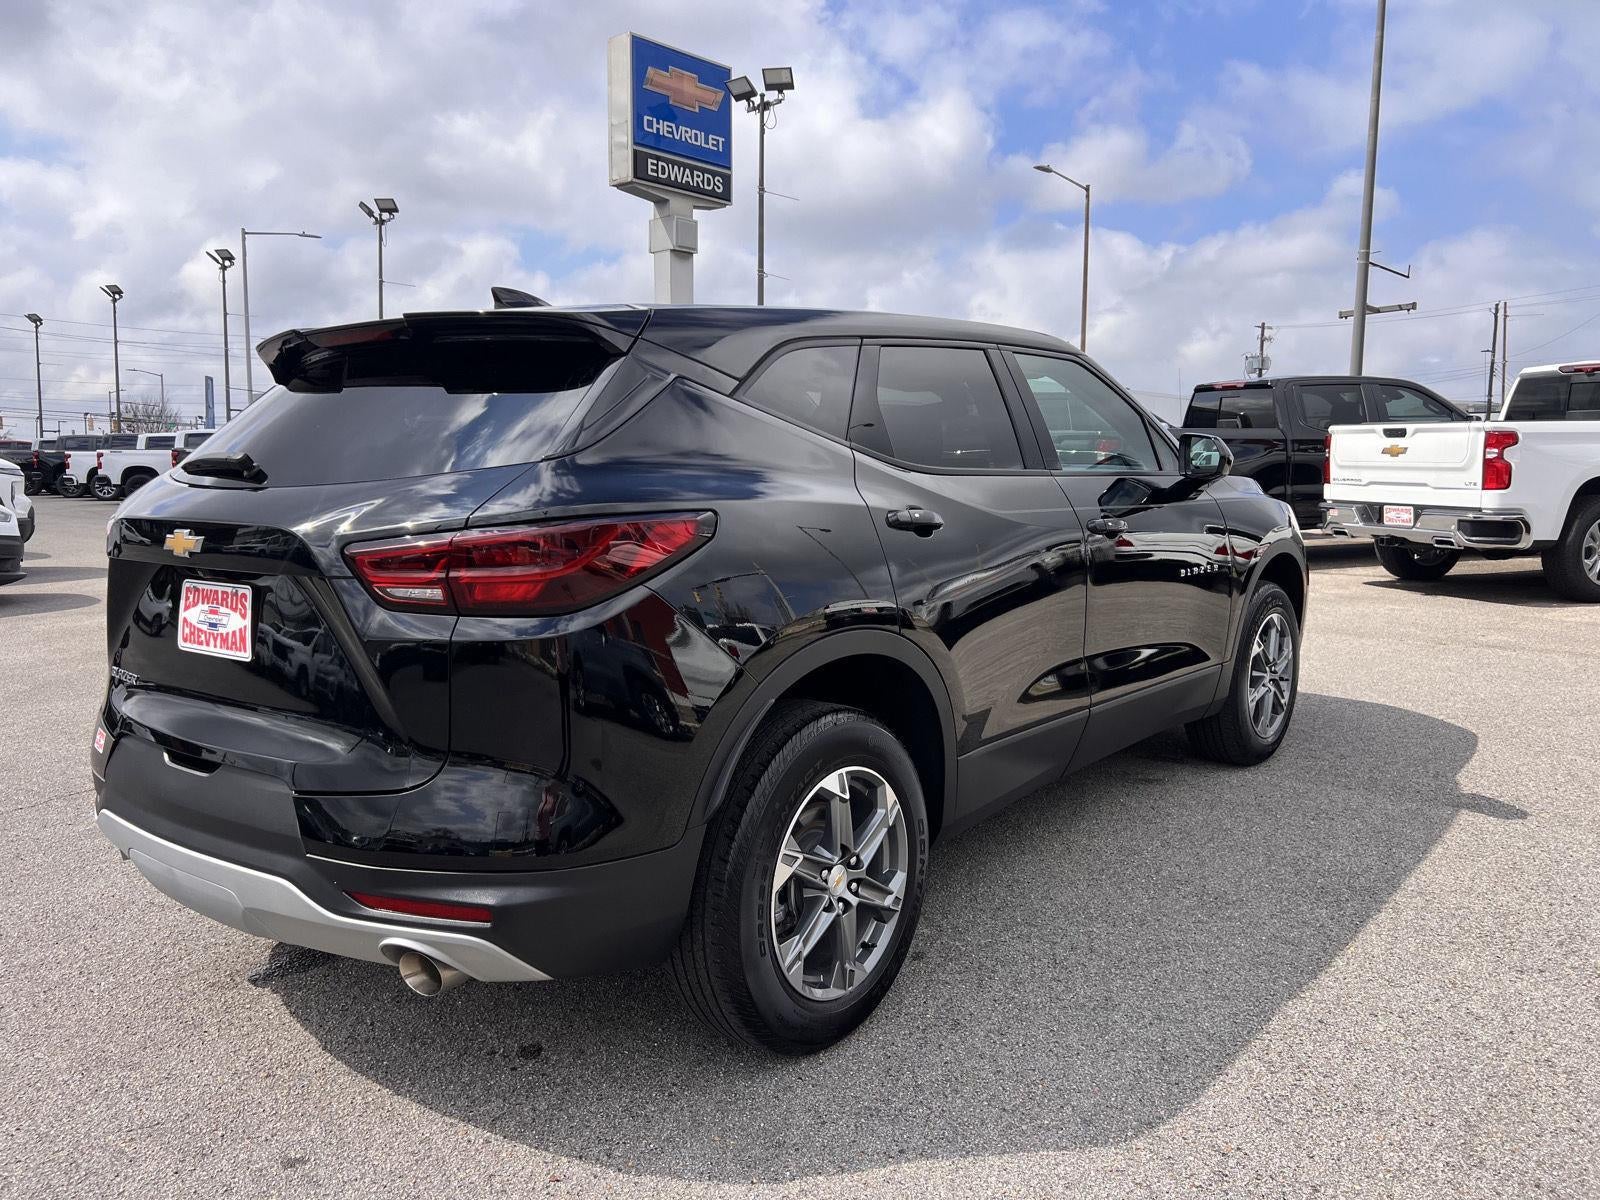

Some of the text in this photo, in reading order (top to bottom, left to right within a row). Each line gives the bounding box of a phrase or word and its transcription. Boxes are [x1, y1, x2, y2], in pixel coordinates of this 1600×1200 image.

[643, 115, 725, 152] CHEVROLET
[647, 157, 724, 193] EDWARDS
[1180, 564, 1219, 577] BLAZER
[183, 586, 248, 621] EDWARDS
[182, 616, 247, 653] CHEVYMAN
[111, 665, 139, 685] BLAZER
